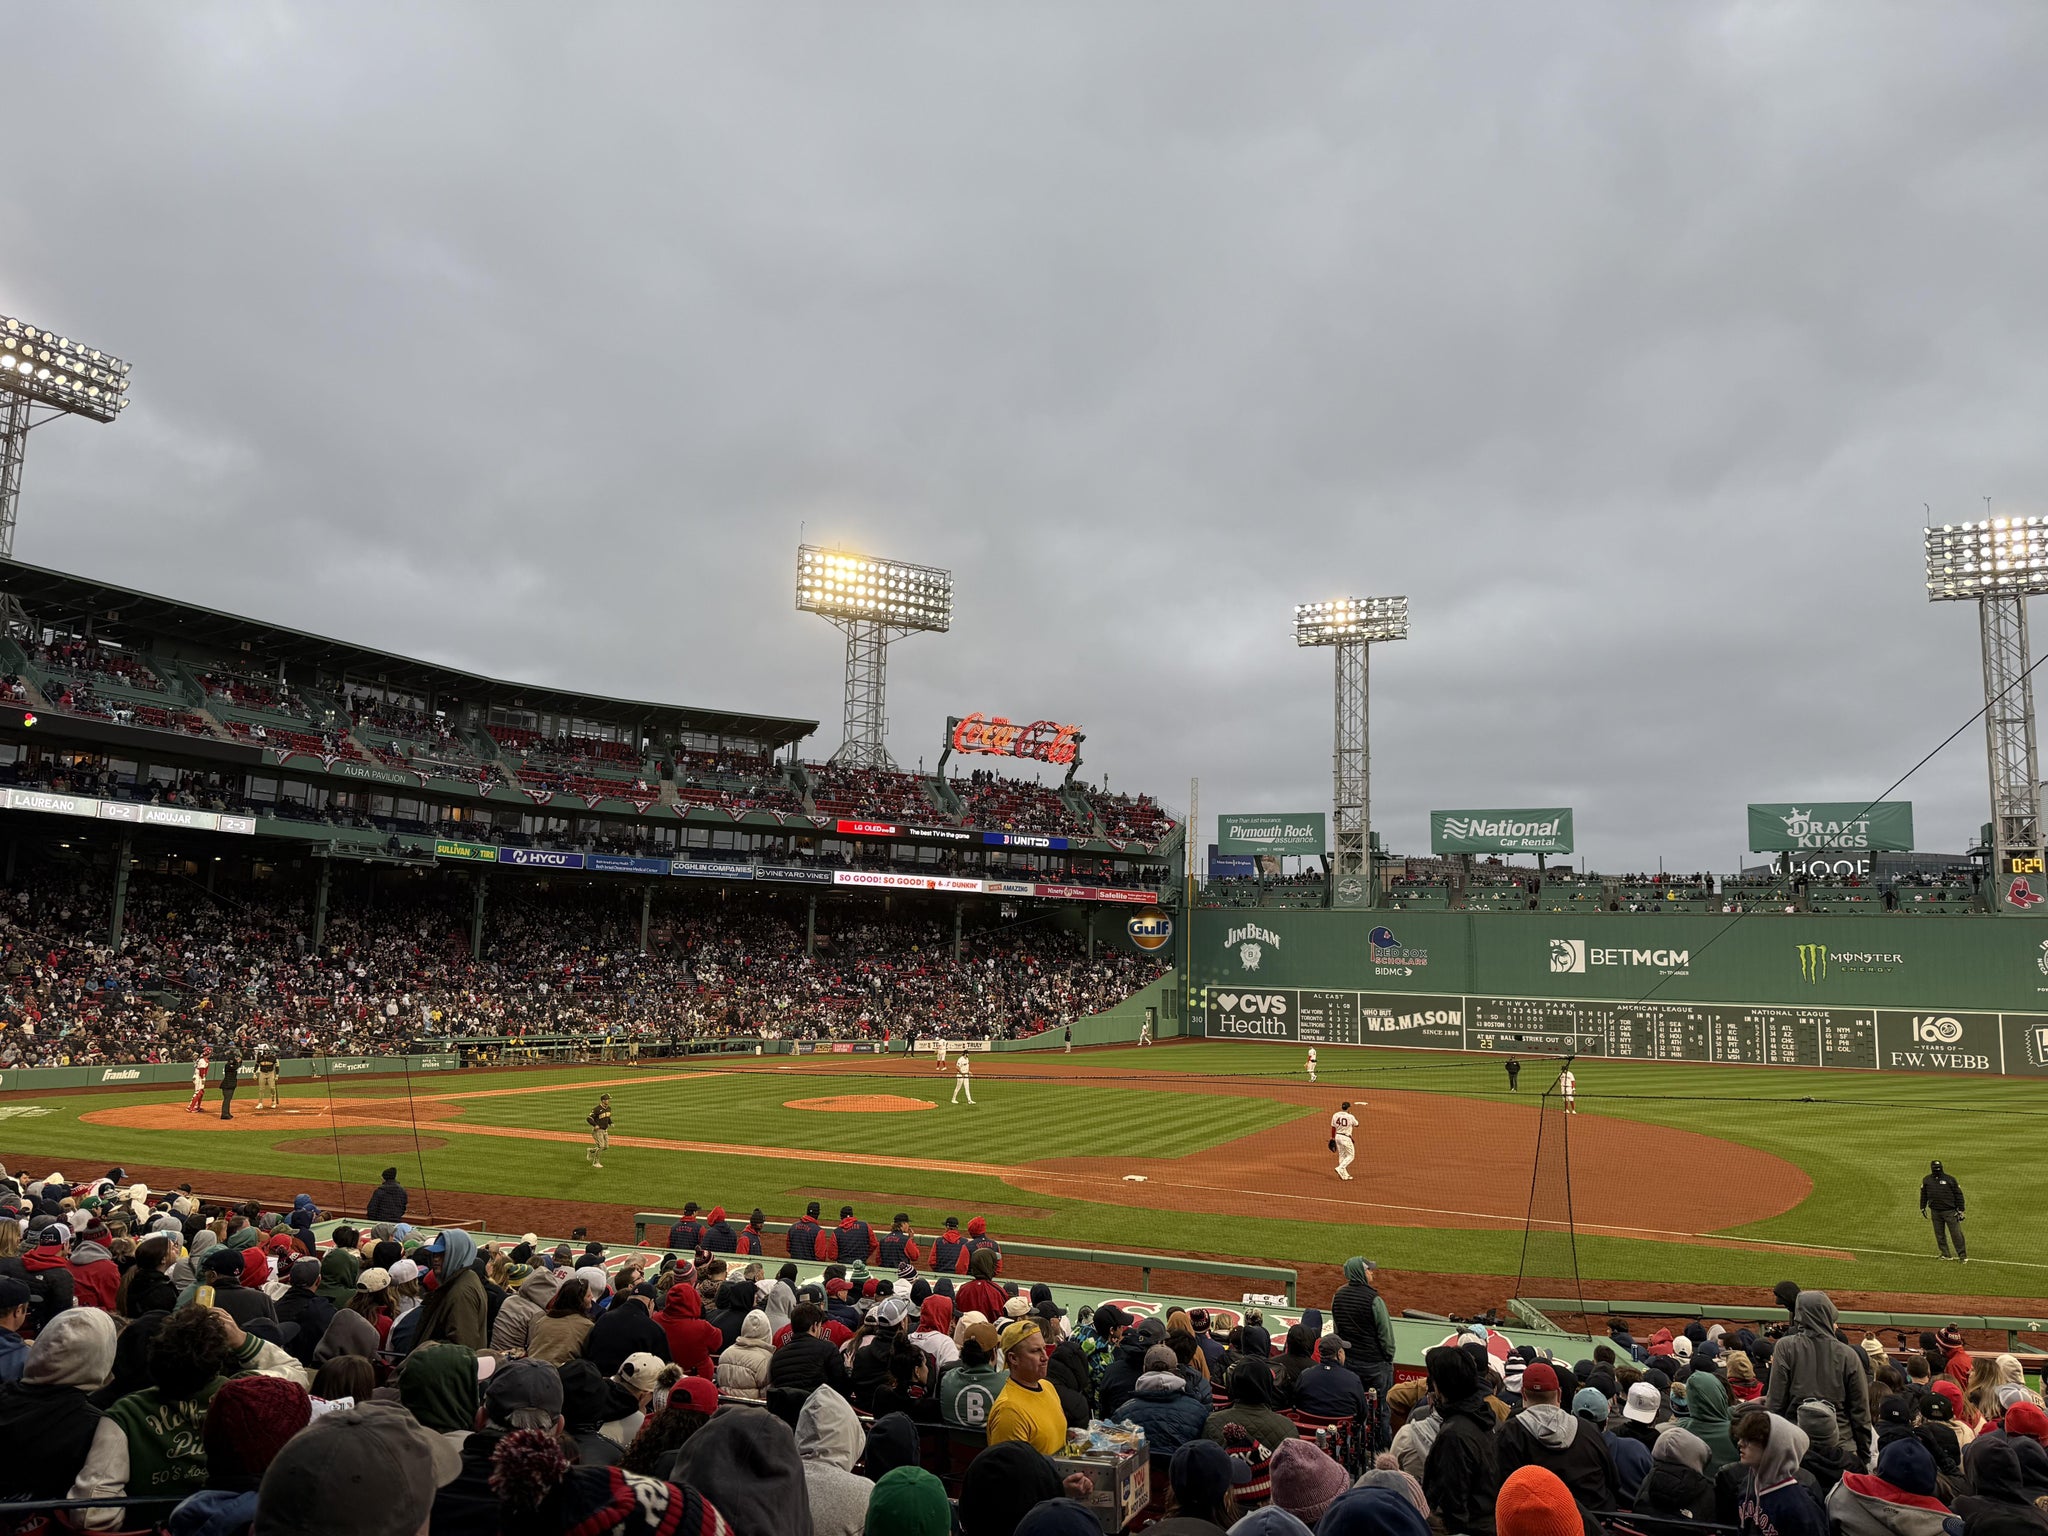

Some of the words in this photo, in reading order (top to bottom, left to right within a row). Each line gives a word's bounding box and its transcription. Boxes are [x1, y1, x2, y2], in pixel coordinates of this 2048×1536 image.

[372, 770, 406, 783] PAVILION
[15, 795, 74, 811] LAUREANO
[109, 806, 130, 818] 0-2
[146, 811, 191, 824] ANDUJAR
[227, 820, 246, 830] 2-3
[1469, 819, 1560, 836] National
[1787, 821, 1870, 837] DRAFT
[1230, 825, 1281, 839] Plymouth
[1284, 825, 1313, 837] Rock
[1014, 835, 1049, 847] UNITED
[1275, 836, 1313, 844] assurance
[1500, 838, 1518, 846] Car
[1521, 838, 1555, 846] Rental
[1798, 834, 1868, 848] KINGS
[437, 844, 470, 855] SULLIVAN
[480, 850, 494, 859] TIRE
[530, 853, 566, 864] HYCU
[673, 862, 707, 871] COGHLIN
[708, 864, 751, 873] COMPANIES
[2012, 858, 2043, 873] 0:29
[766, 870, 804, 878] VINEYARD
[839, 874, 850, 882] SO
[853, 875, 881, 883] GOOD!
[897, 878, 924, 886] GOOD!
[1003, 884, 1028, 893] AMAZING
[1048, 888, 1063, 896] Ninety
[1100, 891, 1127, 899] Safelite
[1130, 921, 1169, 935] Gulf
[1375, 948, 1399, 957] RED
[1403, 949, 1427, 957] SOX
[1591, 949, 1689, 966] BETMGM
[1830, 952, 1903, 964] MONSTER
[1375, 957, 1427, 965] SCHOLARS
[1240, 994, 1286, 1014] CVS
[1220, 1014, 1287, 1035] Health
[1912, 1016, 1963, 1043] 160
[1480, 1040, 1493, 1048] 23
[1891, 1052, 1925, 1066] F.W.
[1930, 1053, 1989, 1069] WEBB
[347, 1063, 369, 1071] TICKET
[102, 1069, 140, 1081] Franklin
[1336, 1117, 1347, 1126] 40
[967, 1391, 984, 1421] B
